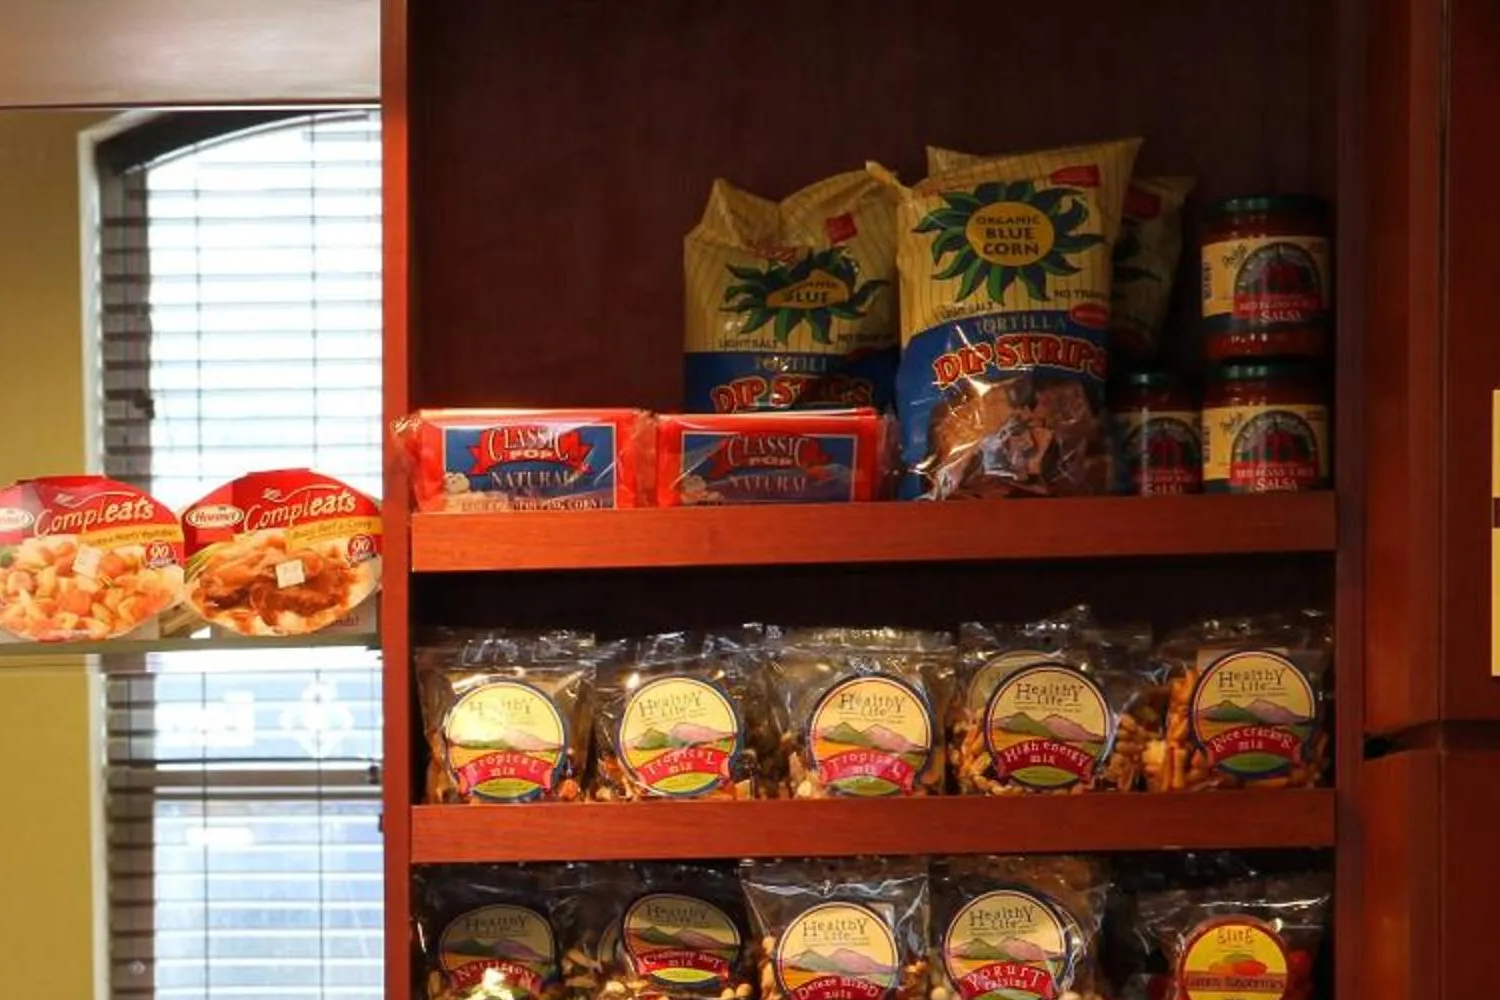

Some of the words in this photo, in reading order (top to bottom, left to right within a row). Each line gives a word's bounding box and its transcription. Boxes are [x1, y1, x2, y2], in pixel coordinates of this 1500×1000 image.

[975, 214, 1041, 227] ORGANIC
[985, 228, 1035, 241] BLUE
[982, 243, 1040, 257] CORN
[976, 315, 1068, 335] TORTILLA
[932, 343, 993, 389] DIP
[995, 333, 1109, 382] STRIPS
[710, 375, 766, 414] DIP
[488, 426, 569, 461] CLASSIC
[510, 449, 552, 459] POP
[726, 434, 811, 467] CLASSIC
[749, 456, 793, 466] POP
[33, 495, 155, 537] Compleats
[243, 487, 357, 534] Compleats
[1217, 667, 1288, 689] Healthy
[1014, 683, 1085, 703] Healthy
[969, 904, 1037, 928] Healthy
[802, 916, 870, 939] Healthy
